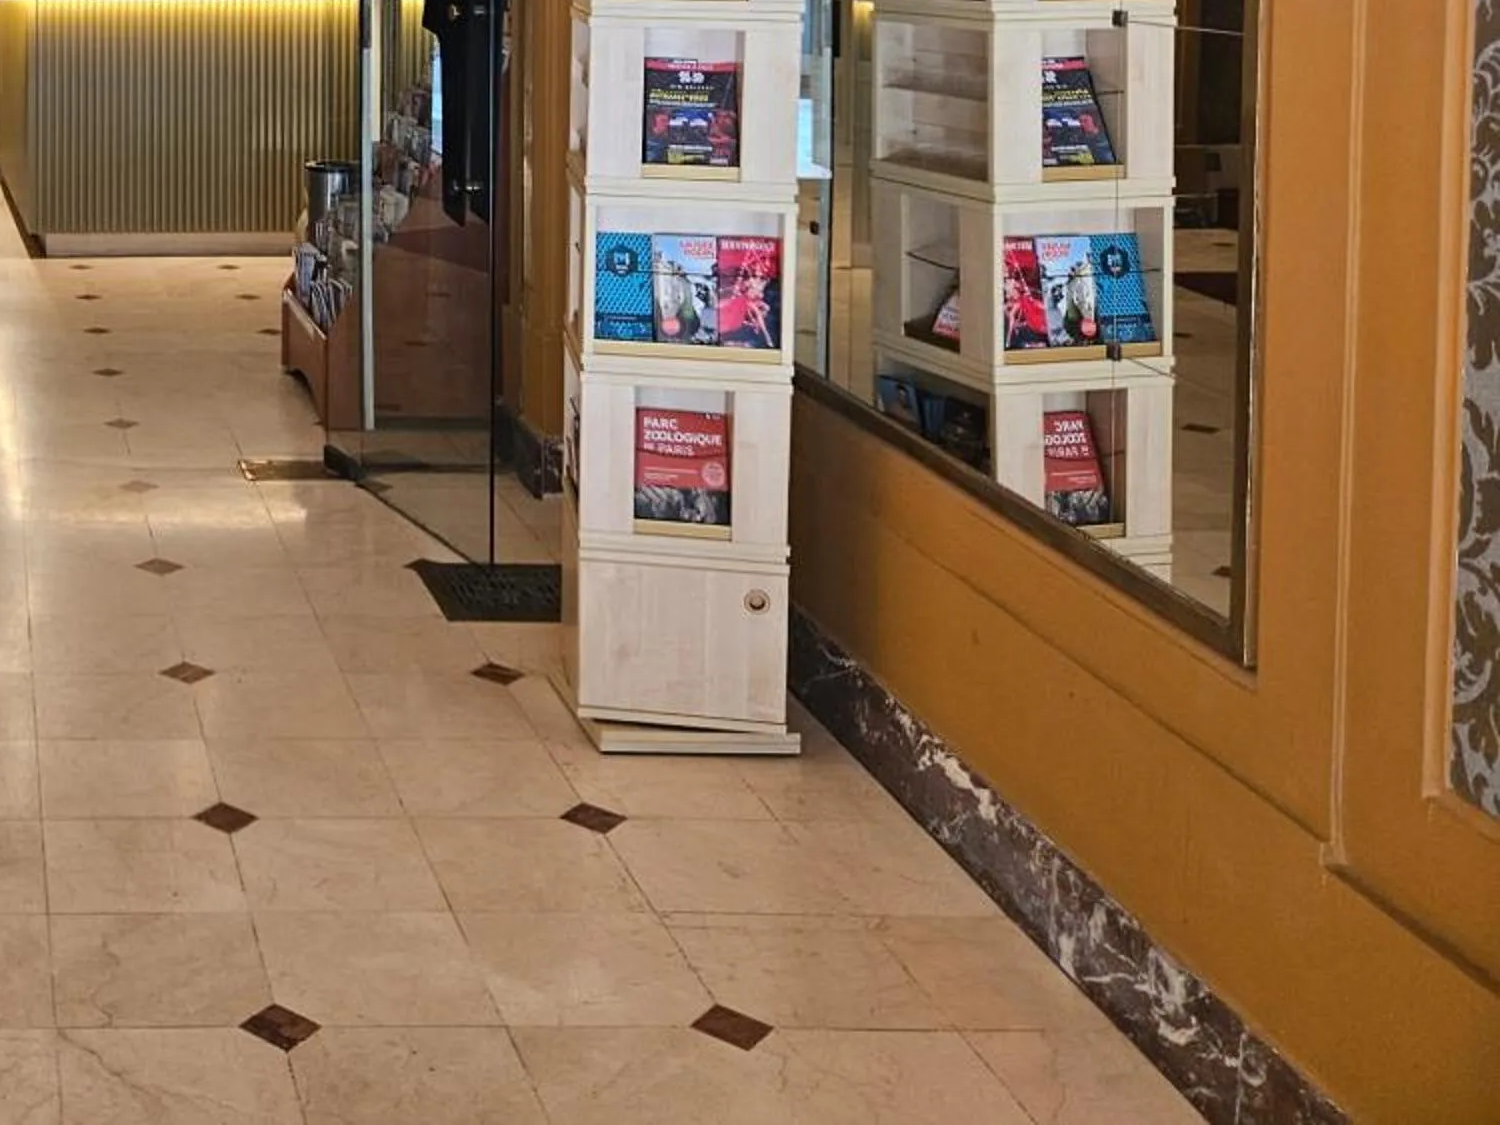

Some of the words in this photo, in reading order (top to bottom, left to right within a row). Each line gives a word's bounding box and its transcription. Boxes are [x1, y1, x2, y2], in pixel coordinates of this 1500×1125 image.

[643, 416, 678, 430] PARC
[643, 429, 722, 446] ZOOLOGIQUE
[658, 443, 695, 457] PARIS
